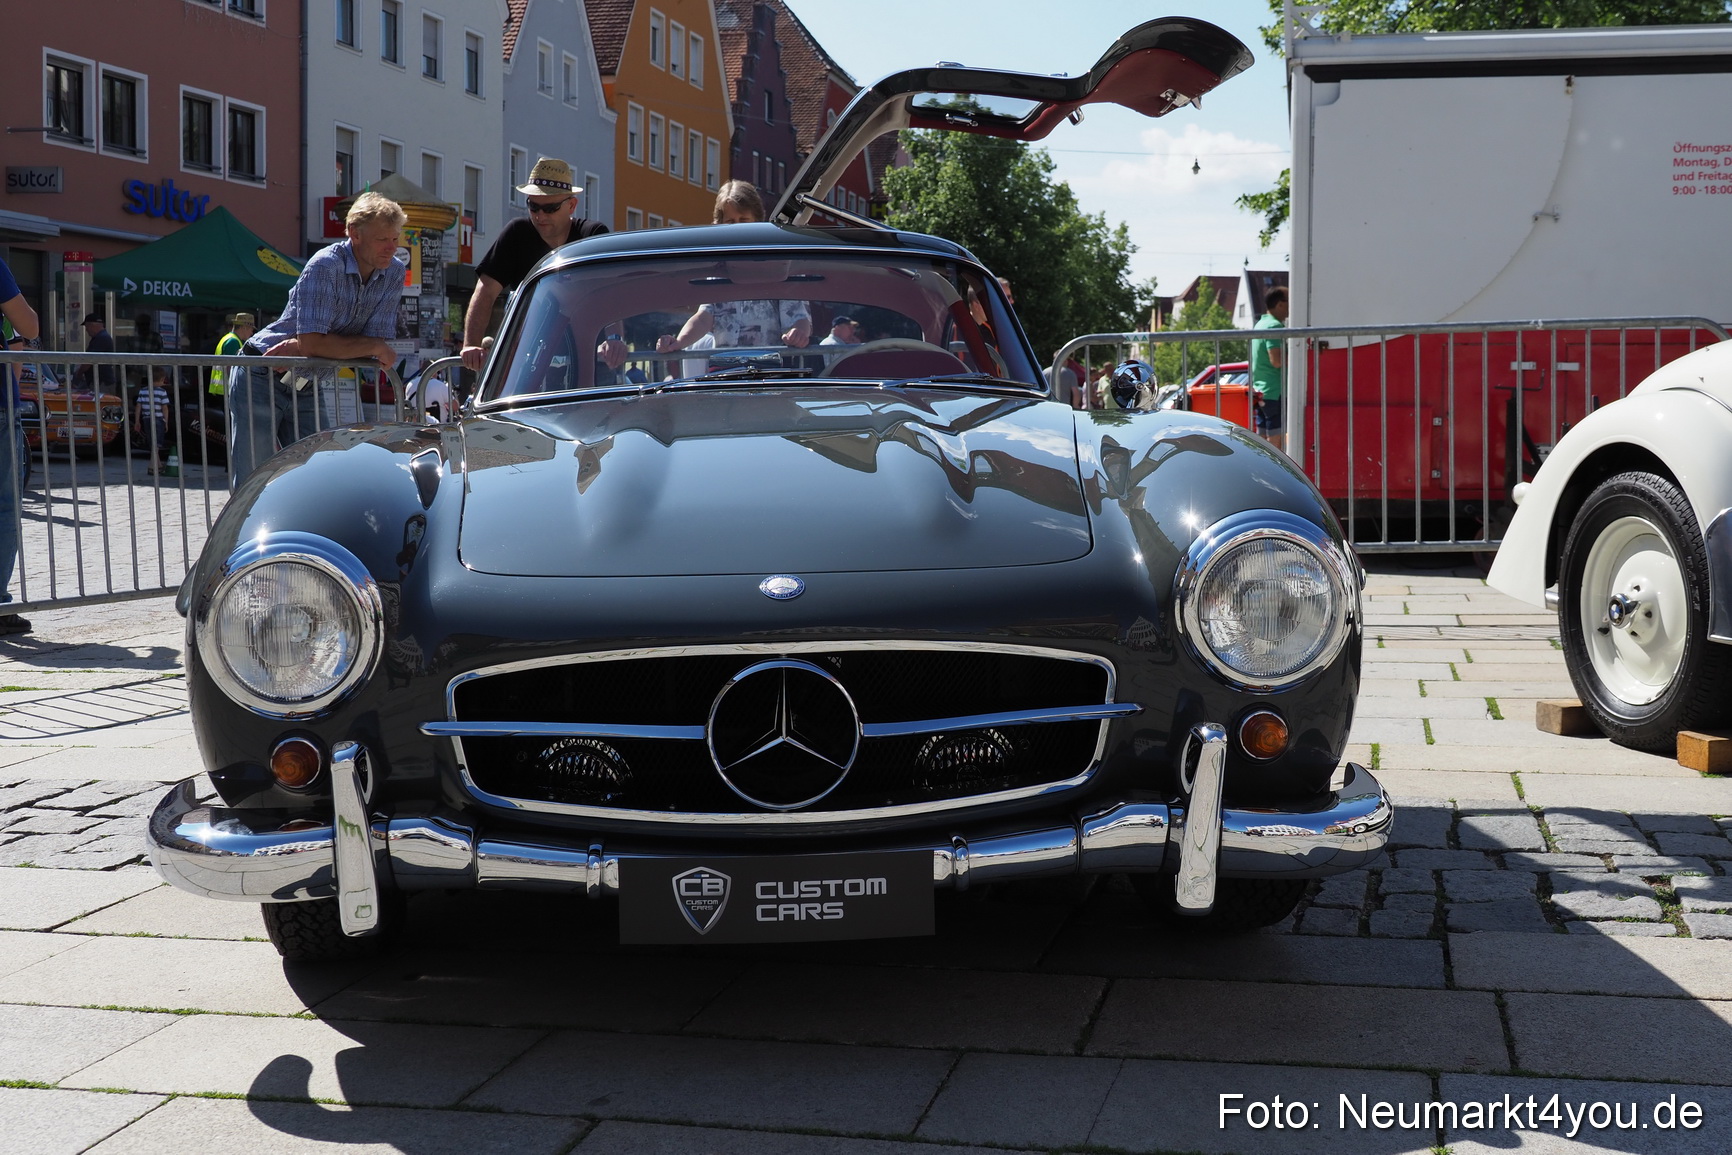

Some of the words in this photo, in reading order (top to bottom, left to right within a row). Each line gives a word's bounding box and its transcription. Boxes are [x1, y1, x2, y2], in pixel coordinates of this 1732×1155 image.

[1673, 158, 1720, 169] Montag,
[1672, 172, 1695, 181] und
[1672, 186, 1696, 195] 9:00
[1704, 185, 1732, 195] 18:00
[143, 280, 193, 297] DEKRA
[679, 878, 724, 897] CB
[755, 877, 887, 899] CUSTOM
[755, 902, 844, 922] CARS
